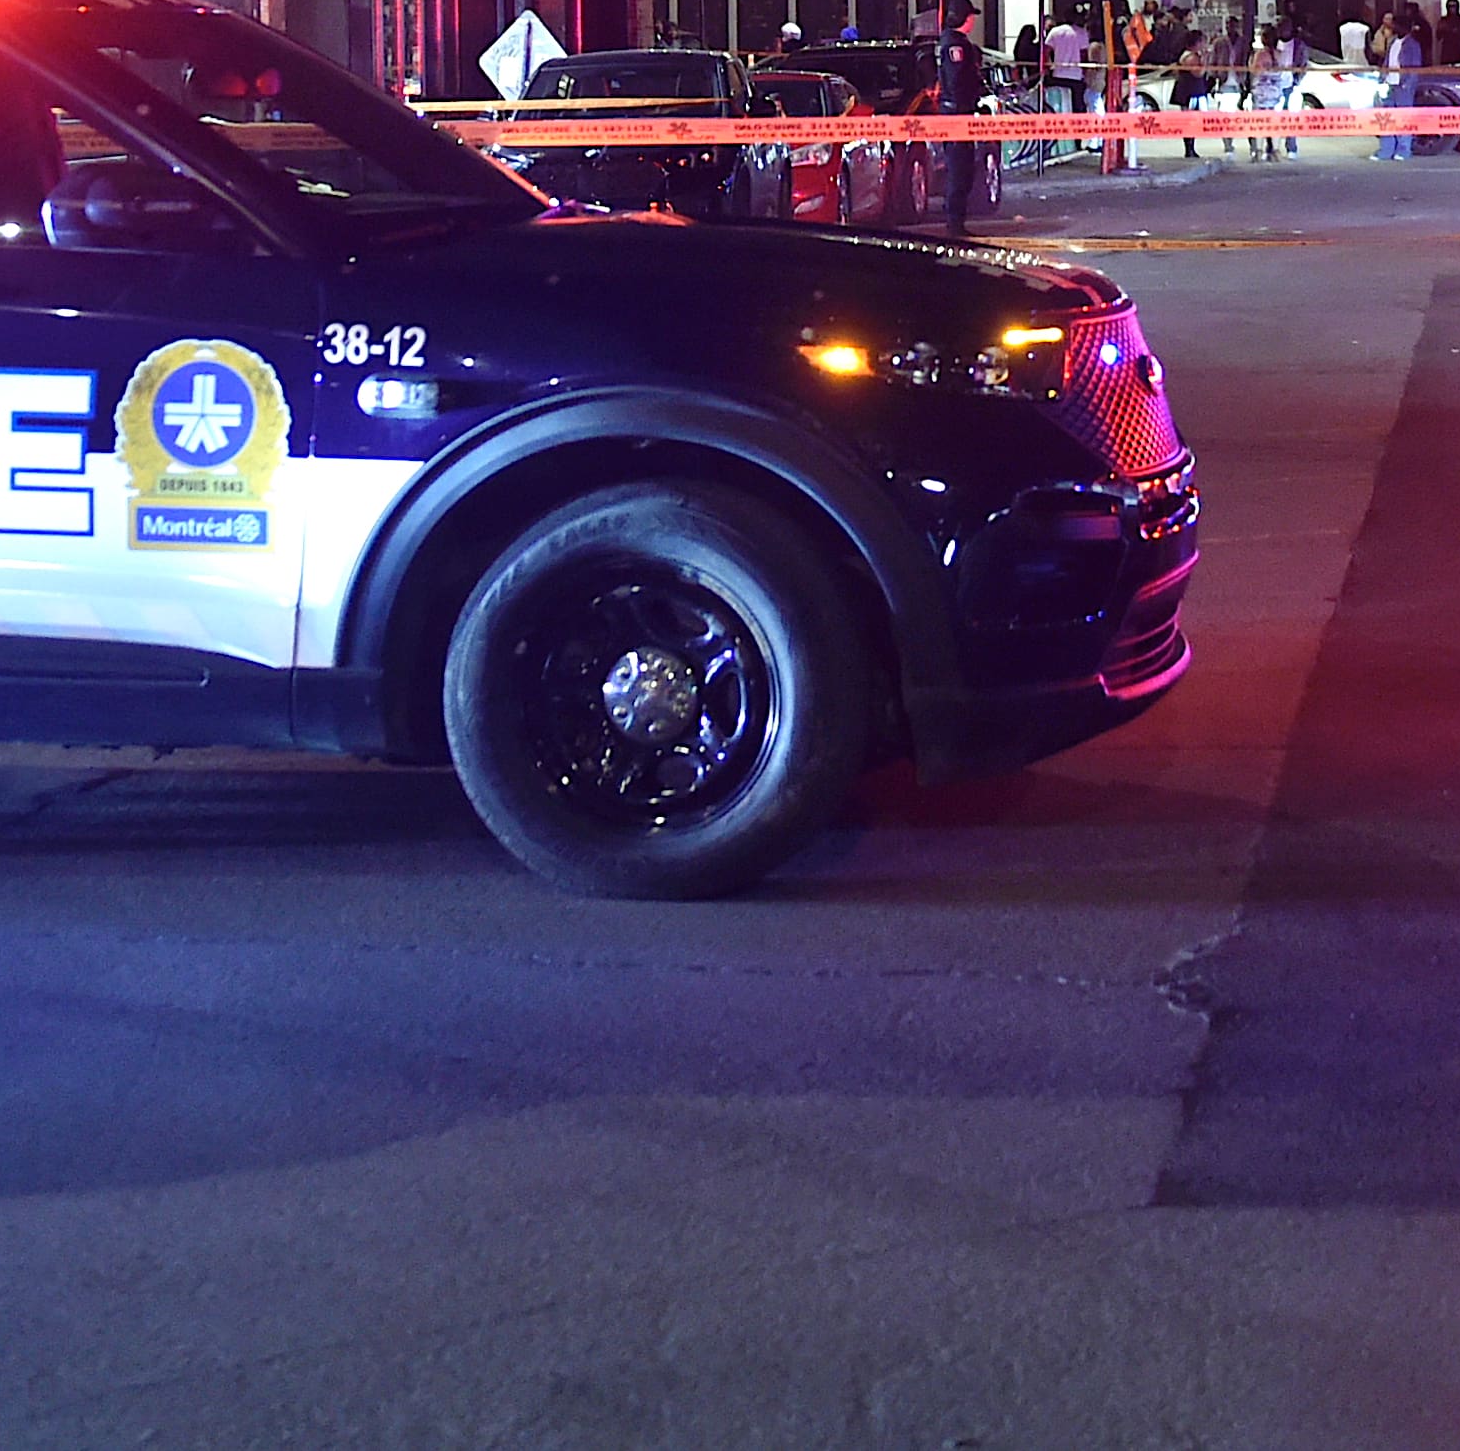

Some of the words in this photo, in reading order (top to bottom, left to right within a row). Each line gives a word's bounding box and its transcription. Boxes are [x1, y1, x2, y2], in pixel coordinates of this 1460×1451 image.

[323, 322, 427, 368] 38-12
[158, 477, 208, 493] DEPUIS
[211, 478, 245, 494] 1843
[142, 513, 234, 538] Montréal
